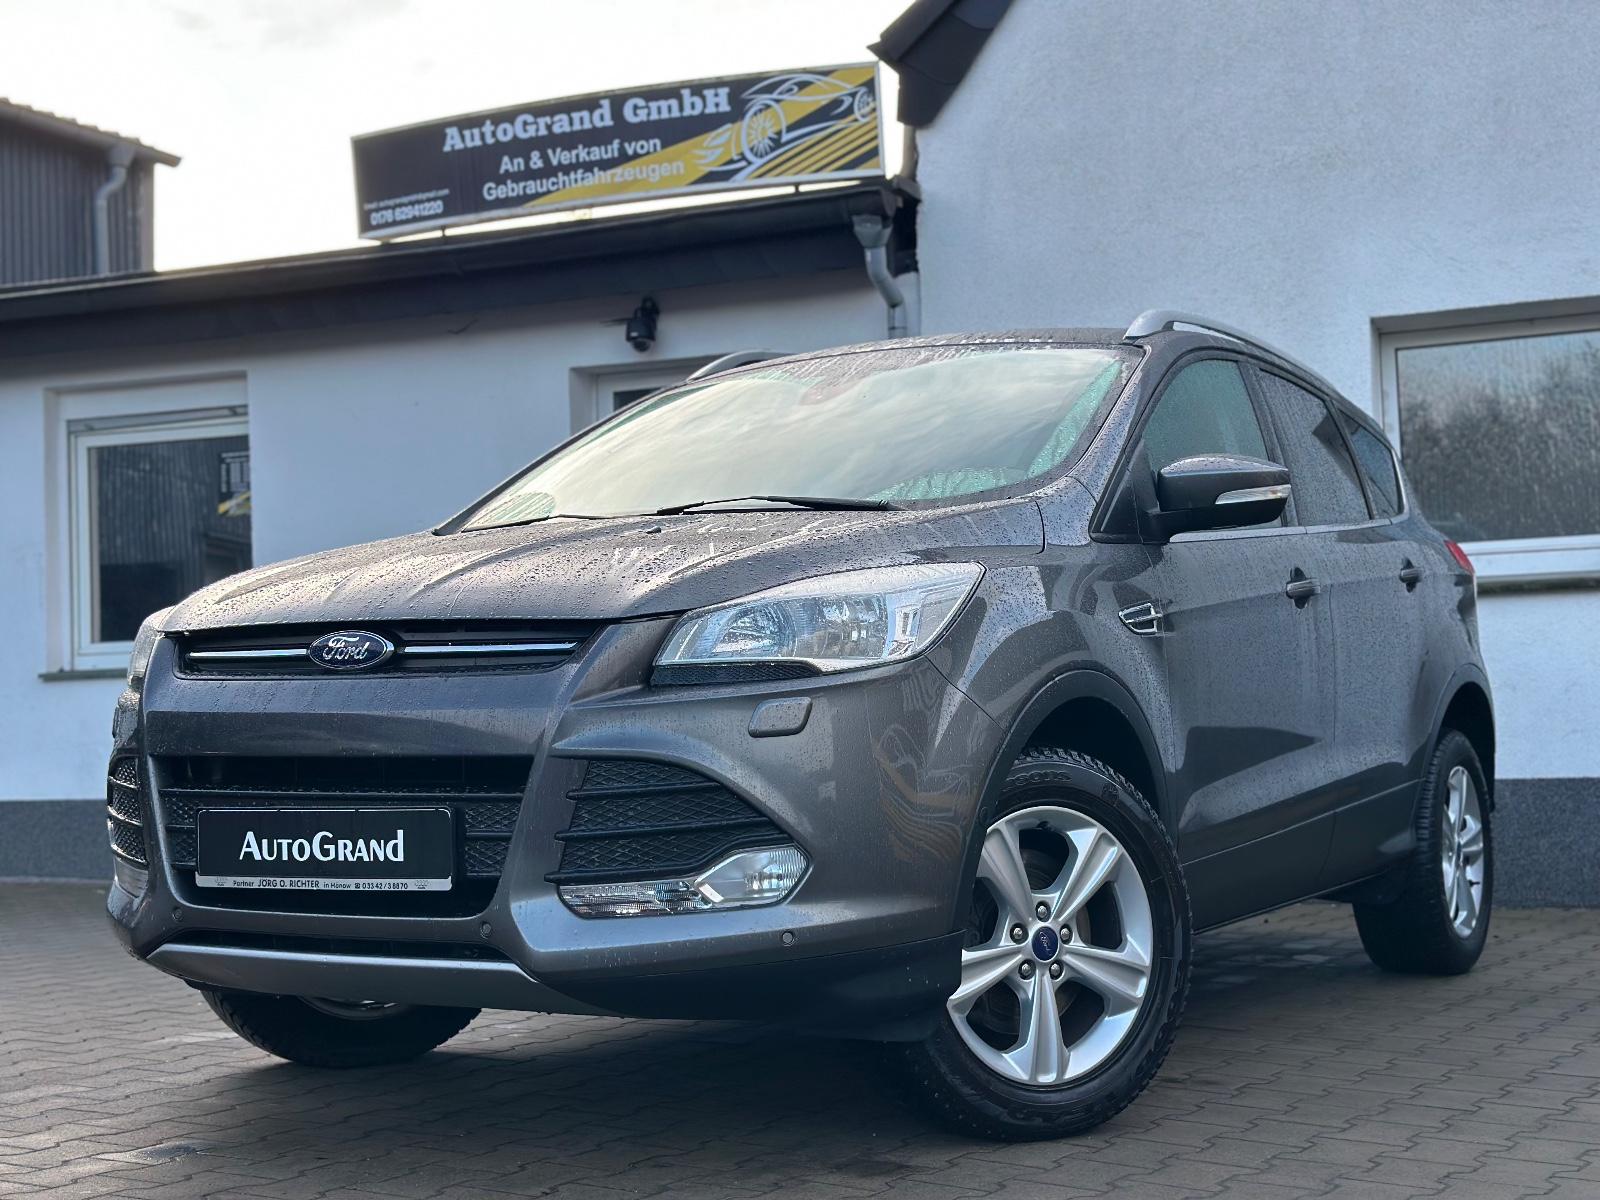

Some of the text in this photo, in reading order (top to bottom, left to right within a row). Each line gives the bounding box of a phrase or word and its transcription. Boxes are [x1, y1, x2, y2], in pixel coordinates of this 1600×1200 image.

[443, 87, 731, 152] AutoGrand GmbH
[500, 138, 661, 174] An & Verkauf von
[482, 160, 685, 201] Gebrauchtfahrzeugen
[322, 636, 370, 660] Ford
[257, 878, 278, 888] JÖRG
[289, 880, 320, 888] RICHTER
[323, 881, 330, 889] in
